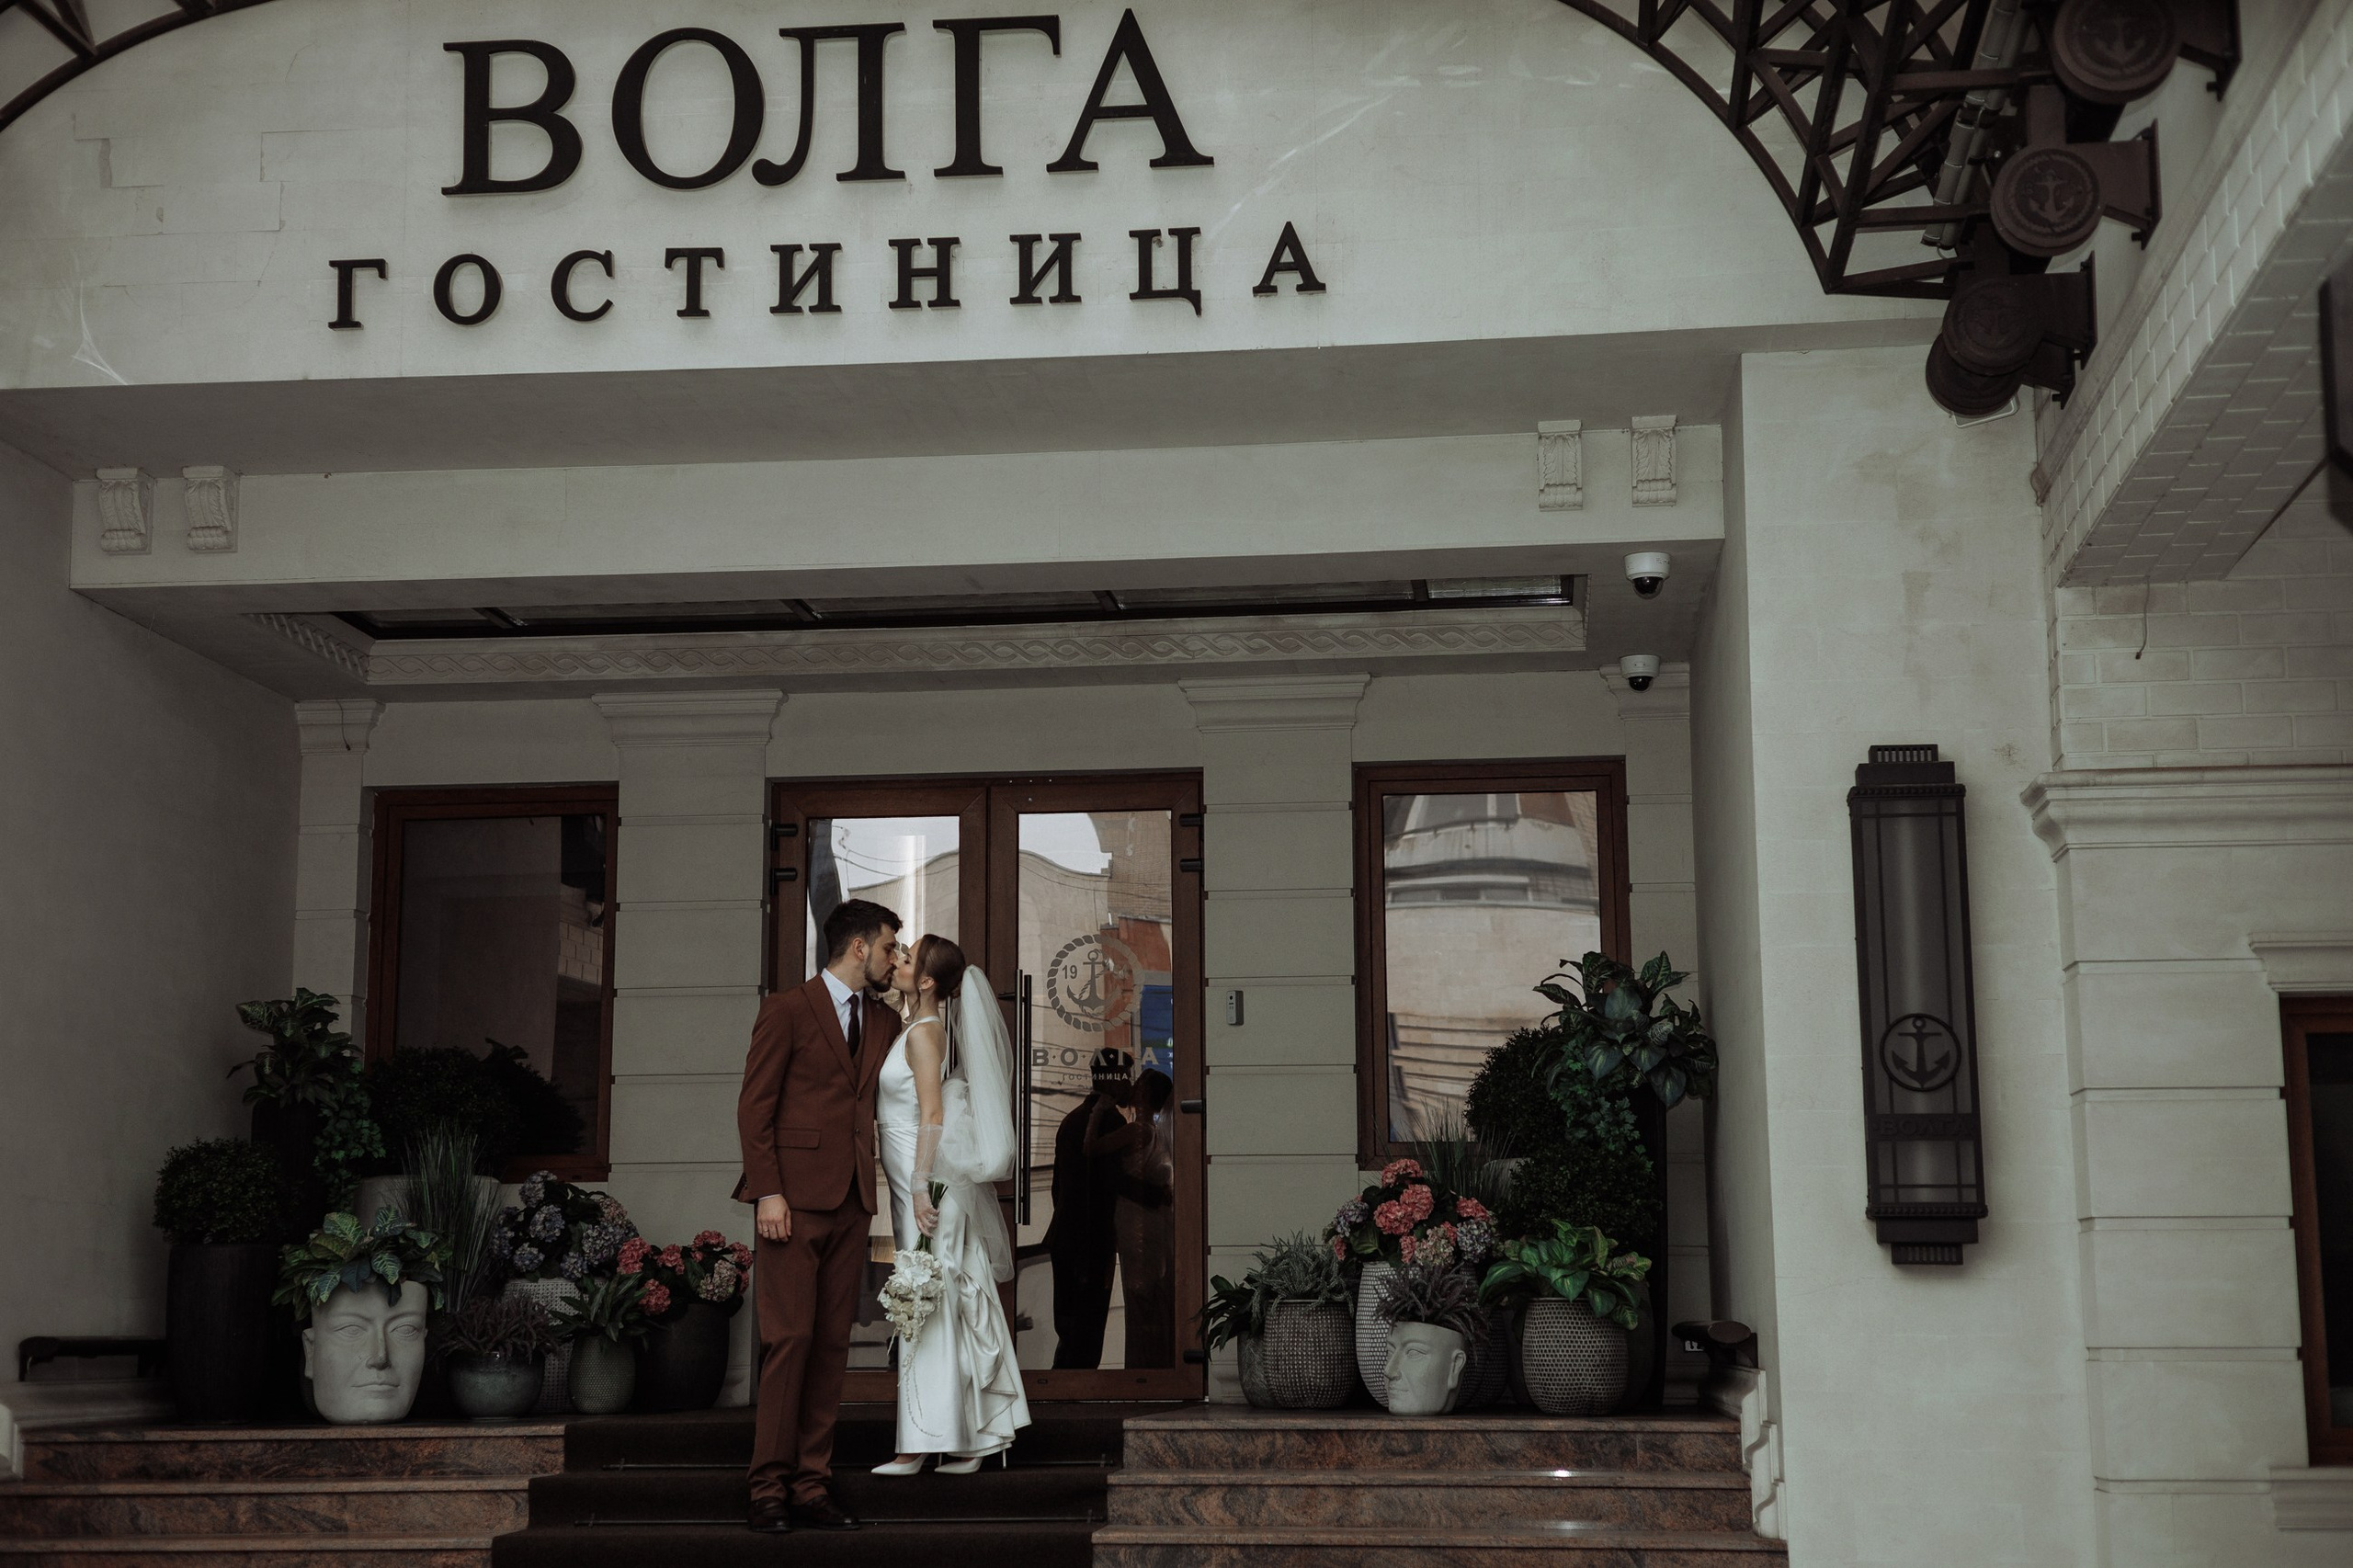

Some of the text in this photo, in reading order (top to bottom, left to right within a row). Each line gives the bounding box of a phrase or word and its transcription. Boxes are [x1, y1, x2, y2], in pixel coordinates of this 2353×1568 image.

[440, 8, 1214, 196] ВОЛГА
[328, 222, 1326, 329] ГОСТИНИЦА
[1062, 964, 1078, 980] 19
